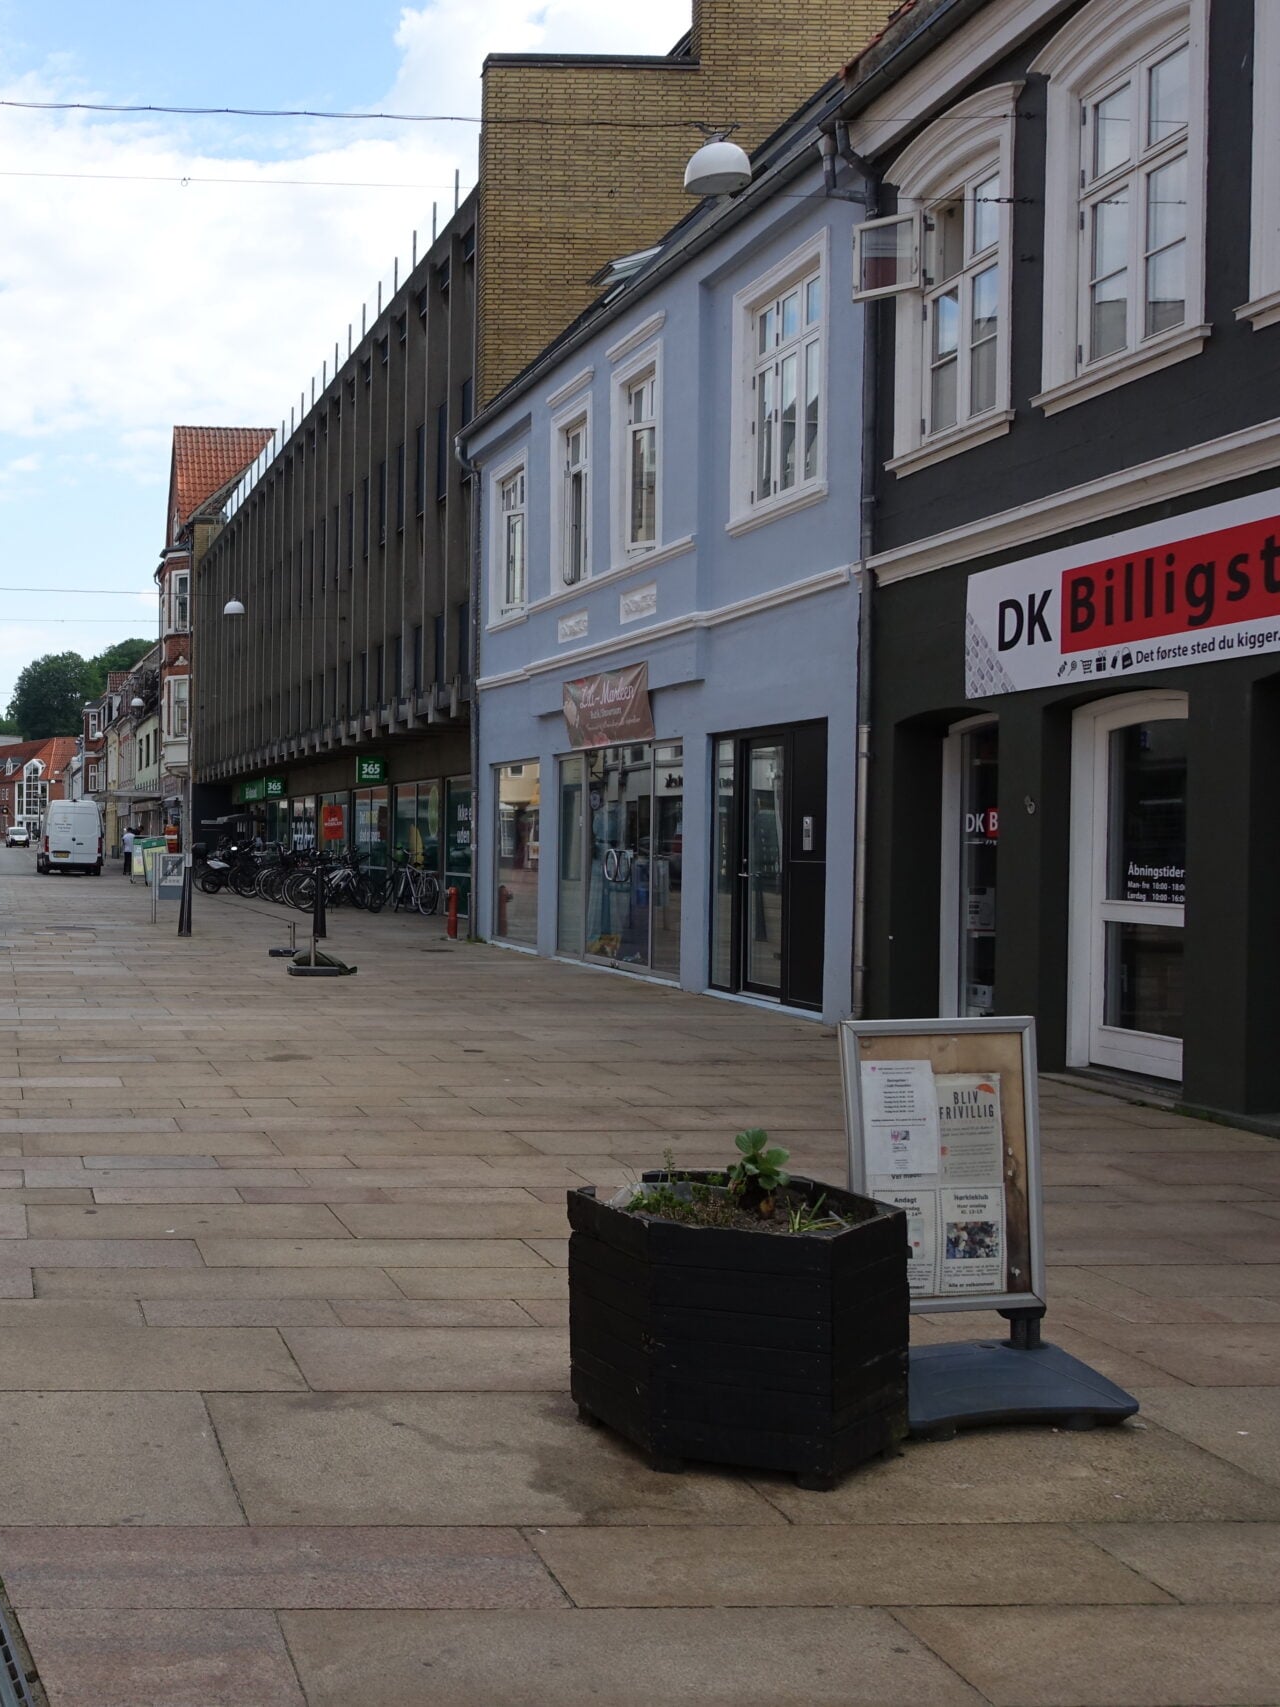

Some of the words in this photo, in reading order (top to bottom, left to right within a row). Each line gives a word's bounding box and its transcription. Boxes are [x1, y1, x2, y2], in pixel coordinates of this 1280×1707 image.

[998, 588, 1053, 652] DK
[1136, 650, 1154, 664] Det
[1156, 644, 1188, 660] første
[1191, 637, 1215, 655] sted
[1218, 635, 1234, 650] du
[362, 763, 380, 775] 365
[268, 782, 282, 791] 365
[965, 813, 985, 833] DK
[953, 1090, 978, 1105] BLIV
[939, 1104, 994, 1119] FRIVILLIG
[894, 1197, 917, 1205] Andagt
